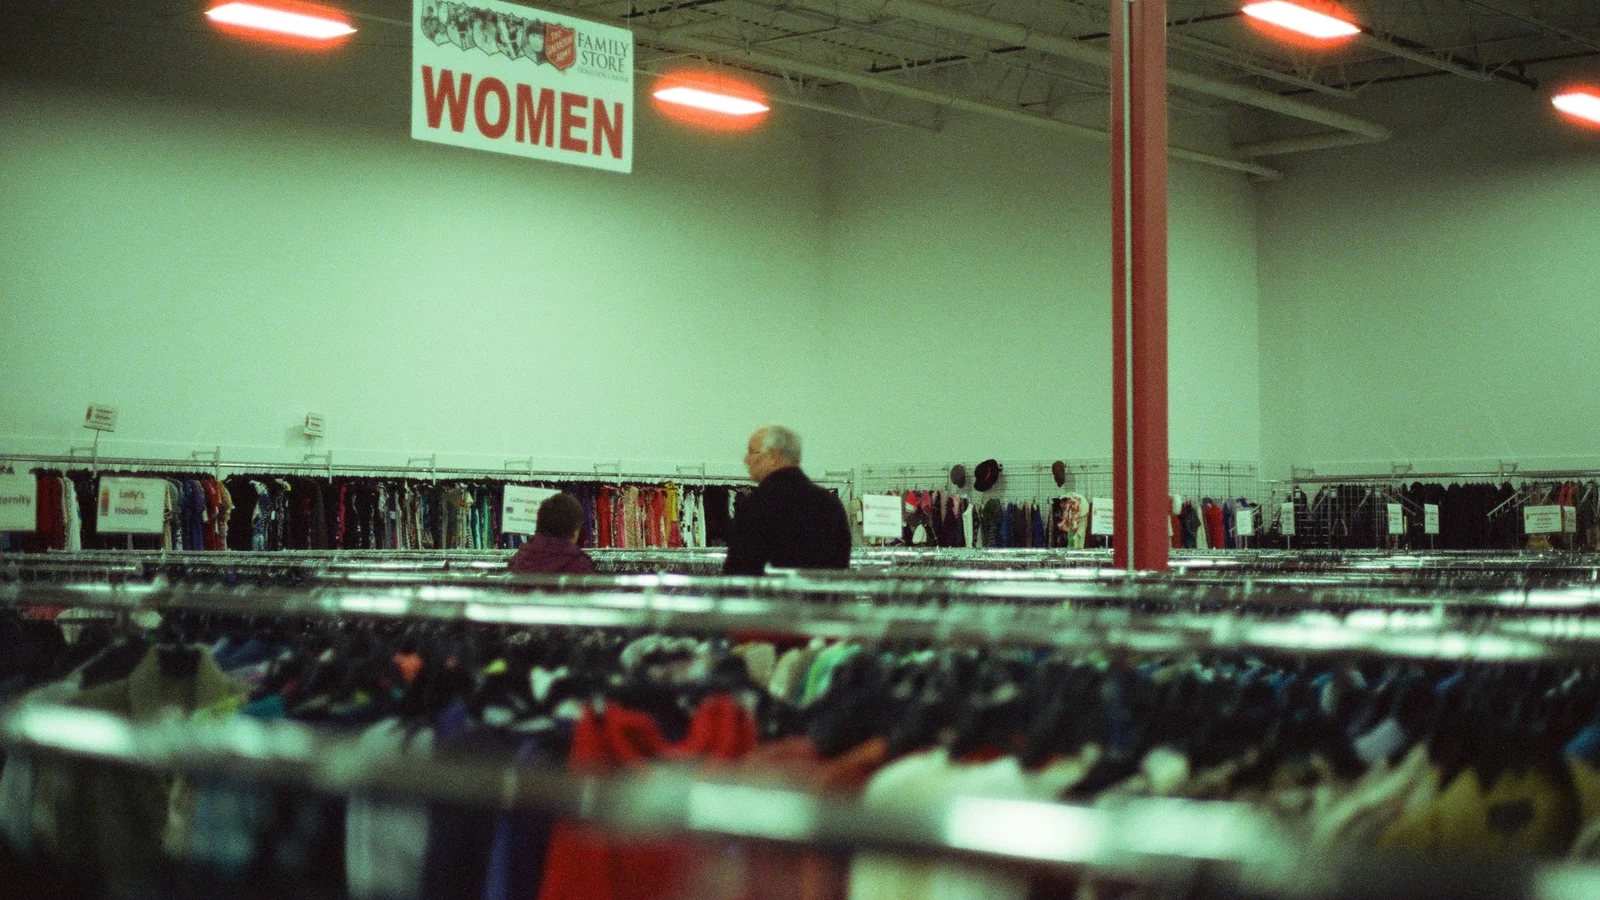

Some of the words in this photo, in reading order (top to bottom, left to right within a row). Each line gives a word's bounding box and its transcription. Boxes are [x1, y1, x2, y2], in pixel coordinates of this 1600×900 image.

[577, 32, 629, 57] FAMILY
[581, 50, 625, 73] STORE
[421, 64, 624, 160] WOMEN
